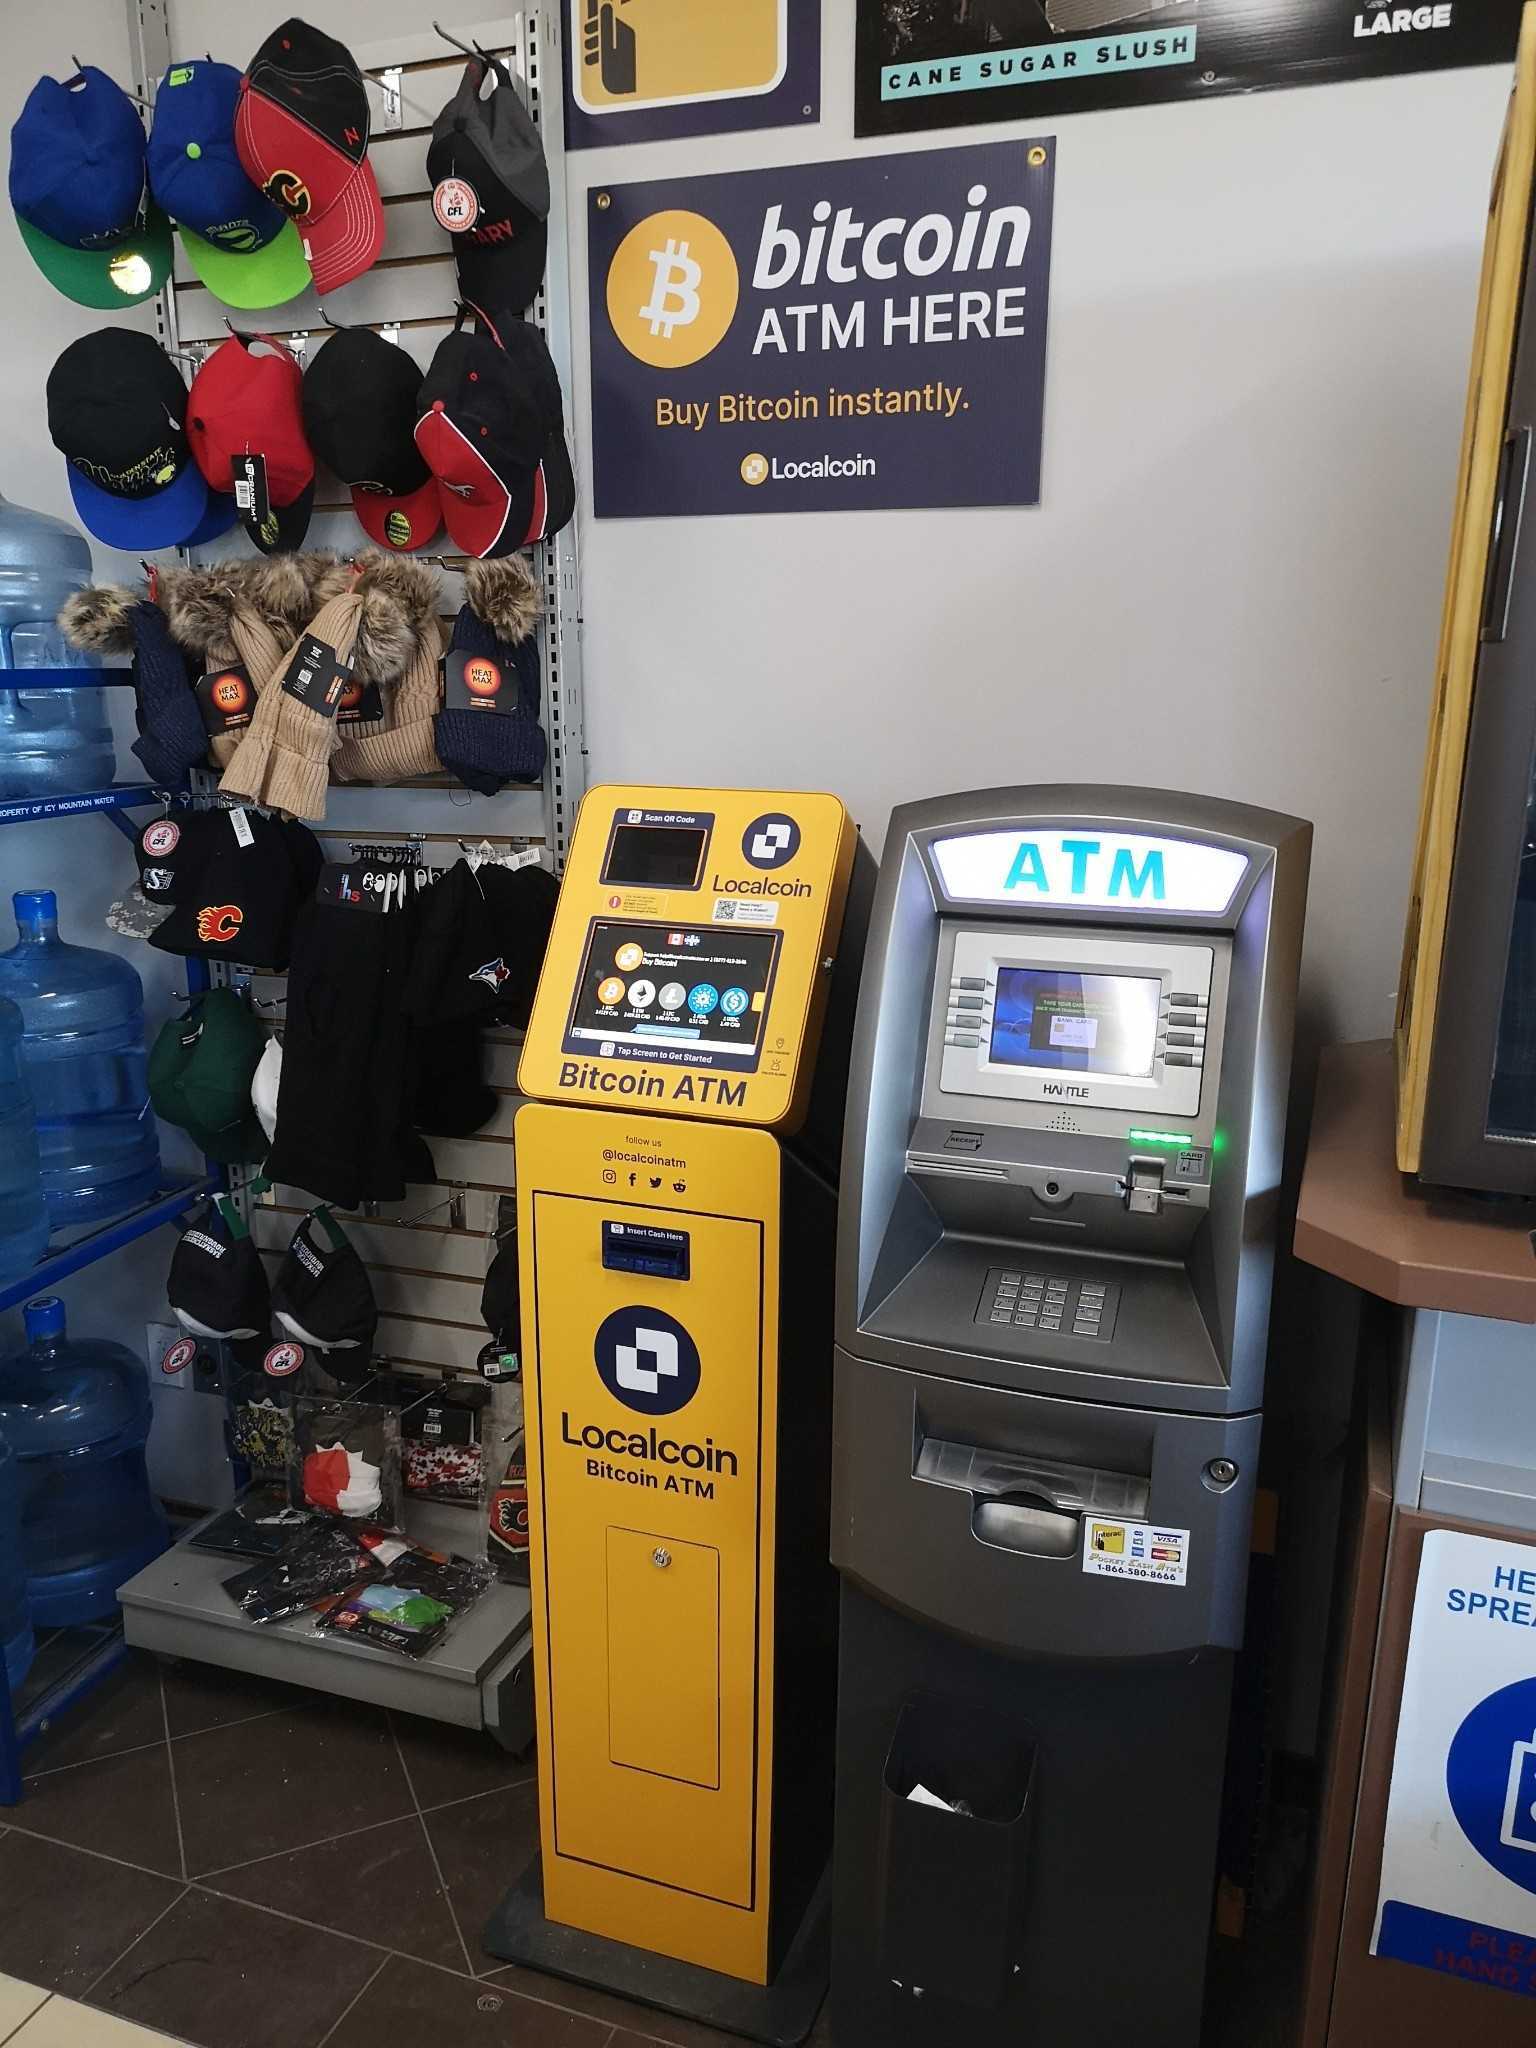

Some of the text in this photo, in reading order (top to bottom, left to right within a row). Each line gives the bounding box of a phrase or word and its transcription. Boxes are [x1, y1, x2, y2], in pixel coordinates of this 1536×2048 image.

[1353, 3, 1453, 38] LARGE
[888, 35, 1188, 90] CANE SUGAR SLUSH
[447, 206, 463, 217] CFL
[752, 184, 1031, 289] bitcoin
[752, 286, 1026, 355] ATM HERE
[655, 382, 969, 431] Buy Bitcoin instantly.
[771, 453, 876, 481] Localcoin
[471, 668, 493, 678] HEAT
[472, 675, 493, 685] MAX
[218, 684, 238, 697] HEAT
[221, 692, 240, 702] MAX
[32, 805, 42, 814] OF
[44, 804, 56, 812] ICY
[58, 799, 92, 810] MOUNTAIN
[93, 796, 115, 806] WATER
[644, 814, 696, 824] Scan QR Code
[1003, 839, 1167, 900] ATM
[712, 873, 813, 899] Localcoin
[617, 1046, 713, 1064] Tap Screen to Get Started
[558, 1061, 748, 1107] Bitcoin ATM
[625, 1135, 662, 1148] follow us
[949, 1136, 980, 1144] RECEIPT
[602, 1149, 686, 1169] @localcoinatm
[1180, 1151, 1203, 1159] CARD
[626, 1226, 684, 1241] Insert Cash Here
[560, 1411, 739, 1477] Localcoin
[586, 1458, 716, 1500] Bitcoin ATM
[1156, 1535, 1178, 1544] VISA
[1097, 1563, 1176, 1581] 1-866-580-8666
[1494, 1565, 1536, 1596] HE
[1446, 1588, 1536, 1627] SPRE
[1433, 1948, 1520, 1985] HAND
